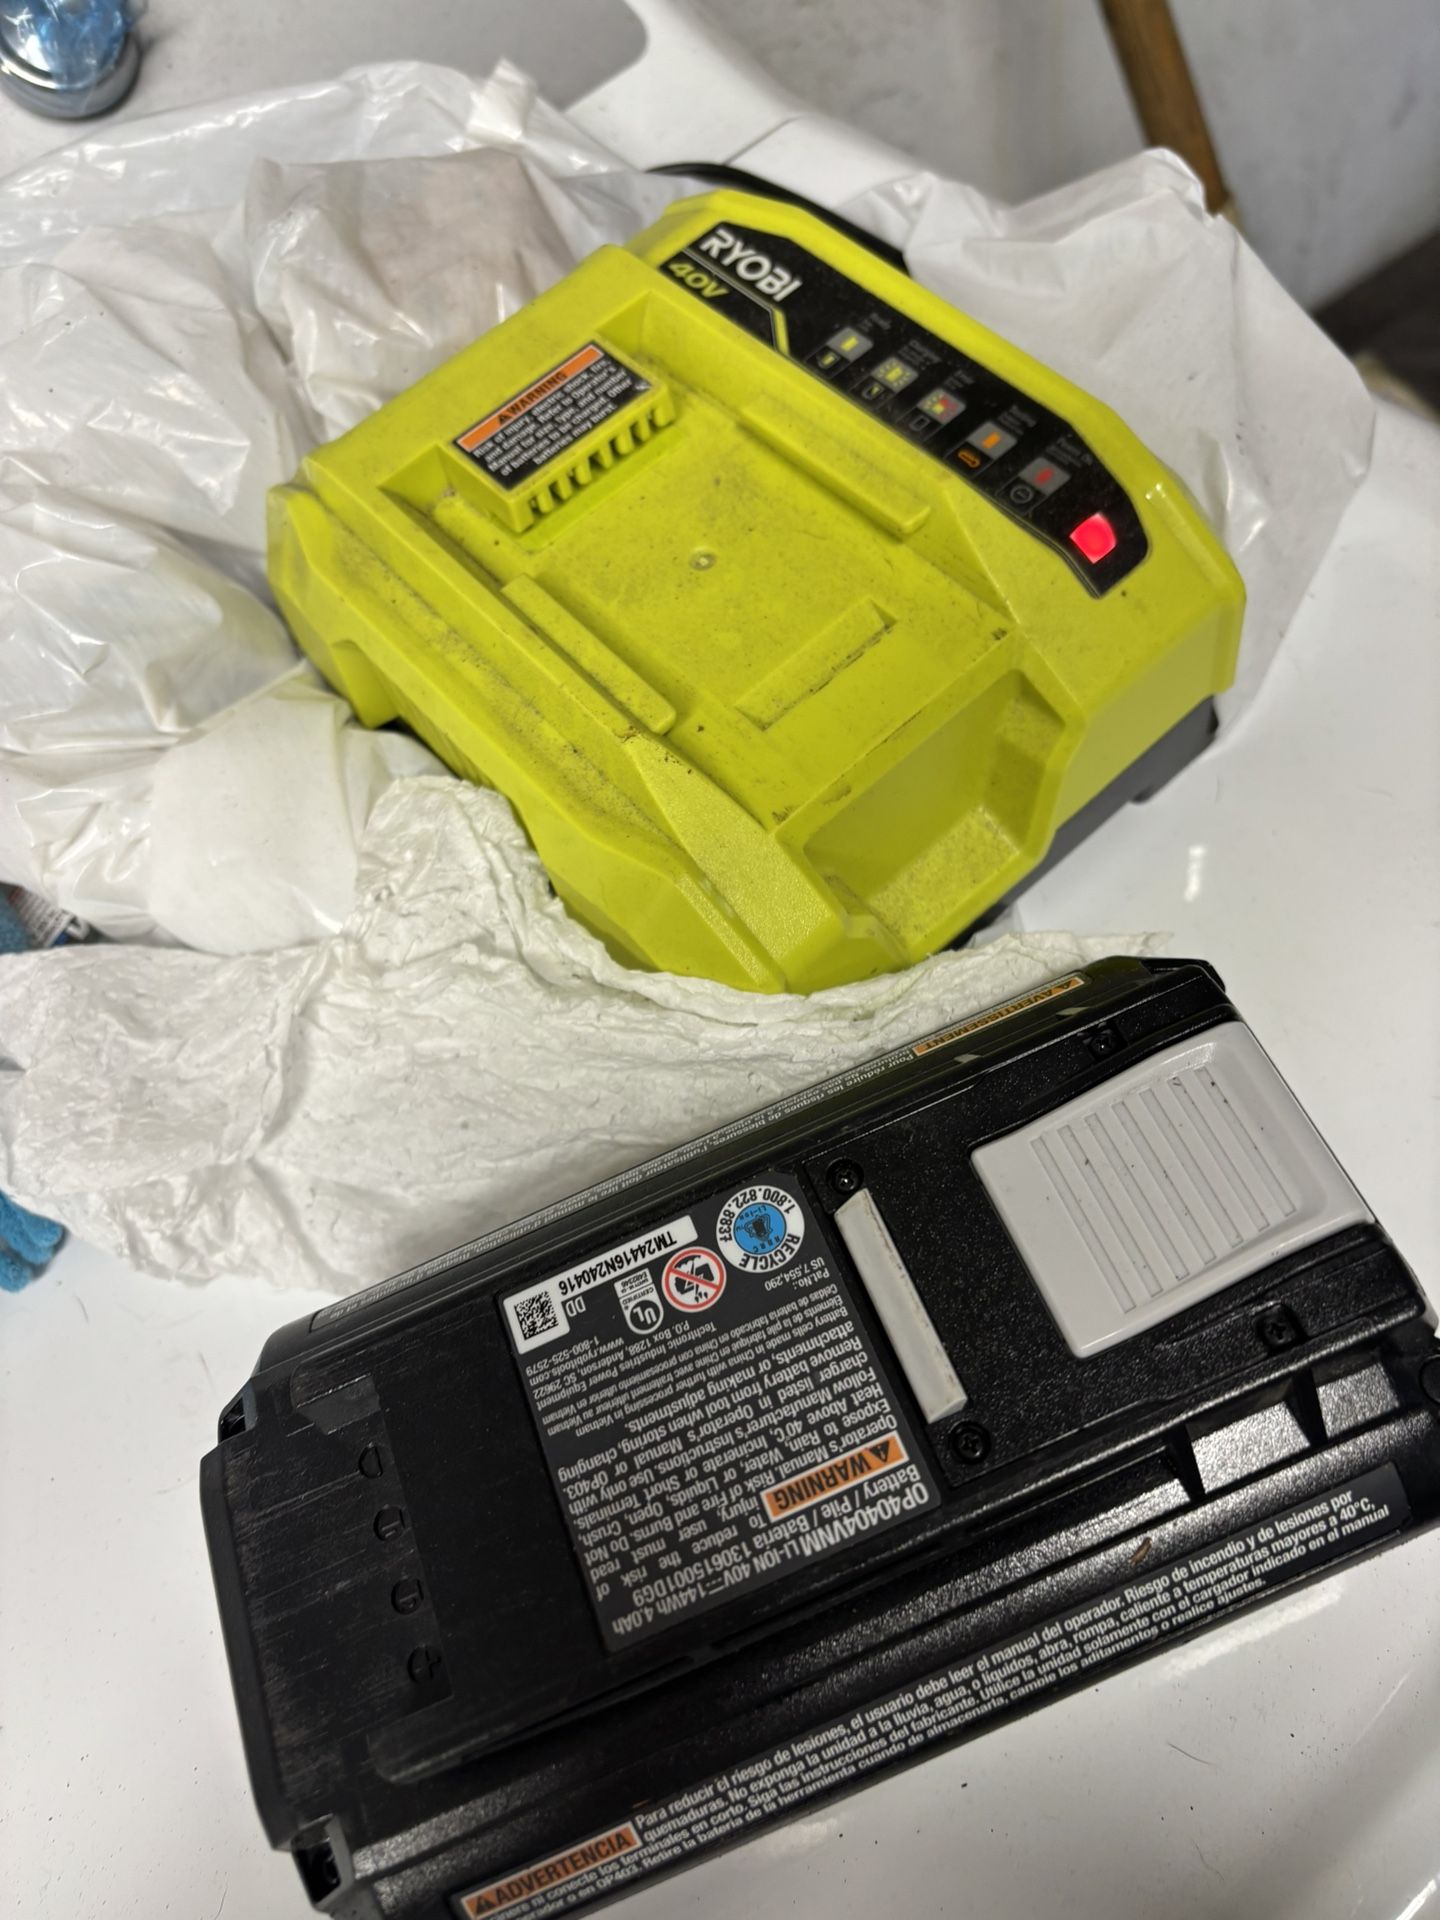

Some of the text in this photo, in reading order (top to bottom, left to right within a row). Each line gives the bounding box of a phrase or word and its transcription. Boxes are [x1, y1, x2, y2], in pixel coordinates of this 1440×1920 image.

[668, 262, 730, 298] 40V
[700, 228, 803, 302] RYOBI
[508, 372, 567, 416] WARNING
[924, 988, 1056, 1050] AVERTISSEMENT
[718, 1187, 796, 1243] 1.800.822.8837
[558, 1231, 678, 1296] TM24416N240416
[739, 1233, 801, 1270] RECYCLE
[764, 1256, 825, 1291] US 7,554,290
[792, 1267, 830, 1290] Pat.No.:
[565, 1295, 586, 1317] DD
[633, 1306, 657, 1325] UL
[671, 1320, 690, 1334] P.O.
[525, 1335, 600, 1377] 1-800-525-2579
[652, 1328, 672, 1343] Box
[529, 1337, 625, 1387] www.ryobitools.com
[536, 1321, 717, 1411] Techtronic Industries Power Equipment
[563, 1372, 577, 1386] SC
[575, 1304, 849, 1437] Battery cells made in China with further processing in Vietnam
[577, 1349, 624, 1377] Anderson,
[624, 1320, 855, 1432] attachments, or making adjustments.
[532, 1378, 563, 1400] 29622
[558, 1335, 863, 1483] Remove battery from tool when storing, changing
[850, 1382, 884, 1407] Heat
[563, 1348, 868, 1499] charger listed in Operator's Manual or OP403.
[806, 1397, 848, 1425] Above
[568, 1366, 877, 1515] Follow Manufacturer's Instructions. Use only with
[702, 1435, 769, 1473] Incinerate
[578, 1394, 892, 1546] Expose to Rain, Water, or Liquids, Open, Crush,
[584, 1414, 898, 1566] Operator's Manual. Risk of Fire and Burns. Do Not
[643, 1475, 681, 1501] Short
[685, 1466, 698, 1480] or
[772, 1452, 872, 1510] WARNING
[863, 1463, 921, 1500] Battery
[573, 1494, 639, 1529] Terminals.
[799, 1482, 929, 1556] OP40404VNM
[820, 1495, 853, 1518] Pile
[589, 1495, 761, 1584] injury, user must read
[596, 1513, 768, 1601] To reduce the risk of
[752, 1539, 800, 1573] LI-ION
[632, 1541, 752, 1606] 130615001DG9
[612, 1607, 654, 1634] 4.0Ah
[635, 1490, 1356, 1829] Para reducir el riesgo de lesiones, el usuario debe leer el manual del operador. Riesgo de incendio y de lesiones por
[495, 1833, 631, 1906] ADVERTENCIA
